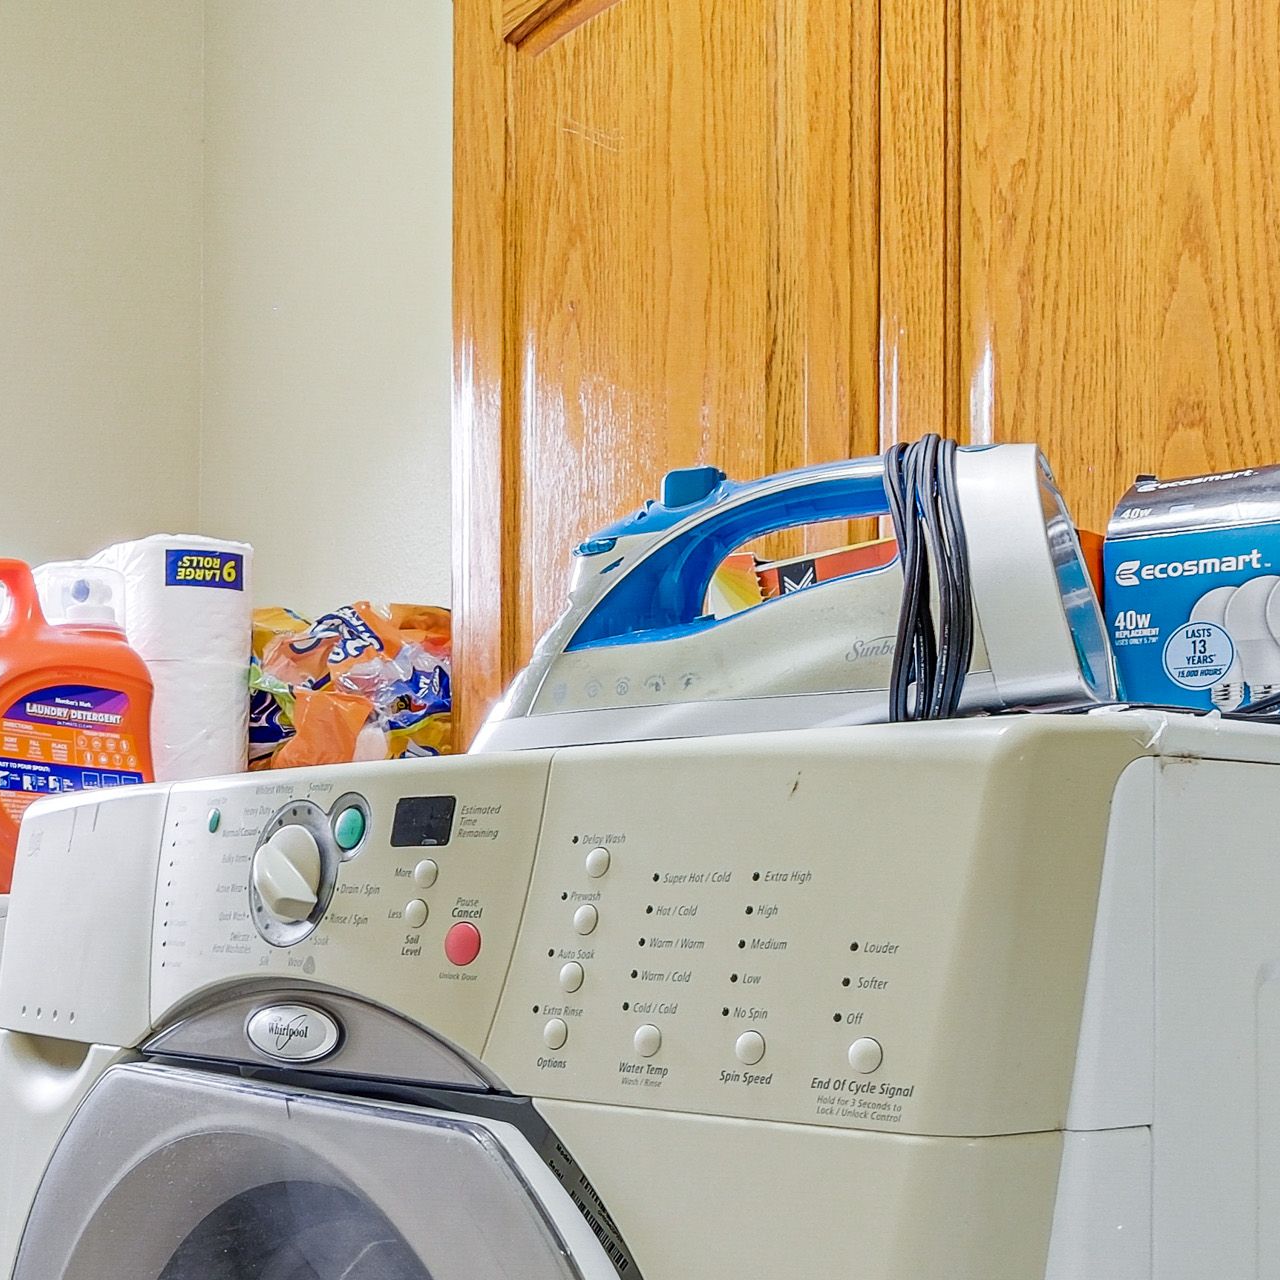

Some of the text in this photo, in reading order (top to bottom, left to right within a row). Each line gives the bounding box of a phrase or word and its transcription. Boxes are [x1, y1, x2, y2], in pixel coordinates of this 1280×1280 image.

[1141, 549, 1261, 579] ecosmart
[176, 560, 236, 582] 9 LARGE
[1115, 628, 1160, 639] REPLACEMENT
[1186, 628, 1212, 639] LASTS
[1191, 639, 1206, 655] 13
[1178, 668, 1223, 678] 15,000 HOURS
[26, 702, 122, 724] LAUNDRY DETERGENT
[461, 804, 501, 816] Estimated
[460, 817, 478, 826] Time
[457, 828, 499, 840] Remaining
[582, 834, 626, 846] Delay Wash
[394, 868, 412, 878] More
[663, 873, 687, 884] Super
[688, 872, 704, 883] Hot
[712, 872, 732, 883] Cold
[764, 871, 812, 884] Extra High
[341, 884, 360, 894] Drain
[364, 884, 380, 895] Spin
[456, 897, 480, 907] Pause
[570, 892, 601, 900] Prewash
[388, 910, 402, 919] Less
[452, 907, 483, 919] Cancel
[656, 906, 671, 916] Hot
[678, 905, 698, 916] Cold
[757, 904, 778, 918] High
[329, 914, 348, 924] Rinse
[353, 915, 369, 926] Spin
[404, 935, 420, 944] Soil
[649, 938, 673, 948] Warm
[680, 939, 705, 950] Warm
[750, 939, 788, 950] Medium
[401, 946, 422, 956] Level
[864, 942, 900, 954] Louder
[558, 949, 595, 960] Auto Soak
[439, 972, 478, 982] Unlock Door
[640, 970, 665, 982] Warm
[672, 971, 692, 982] Cold
[742, 974, 762, 984] Low
[857, 977, 888, 990] Softer
[542, 1006, 584, 1017] Extra Rinse
[633, 1002, 652, 1014] Cold
[658, 1003, 678, 1014] Cold
[734, 1007, 768, 1021] No Spin
[846, 1013, 864, 1025] Off
[268, 1022, 309, 1041] Whirlpool
[536, 1056, 566, 1069] Options
[618, 1062, 668, 1077] Water Temp
[621, 1078, 638, 1086] Wash
[644, 1079, 662, 1088] Rinse
[720, 1070, 772, 1086] Spin Speed
[810, 1078, 914, 1098] End Of Cycle Signal
[817, 1095, 902, 1112] Hold for 3 Seconds to
[816, 1106, 834, 1116] Lock
[841, 1108, 868, 1119] Unlock
[870, 1111, 902, 1122] Control
[555, 1143, 573, 1165] Model
